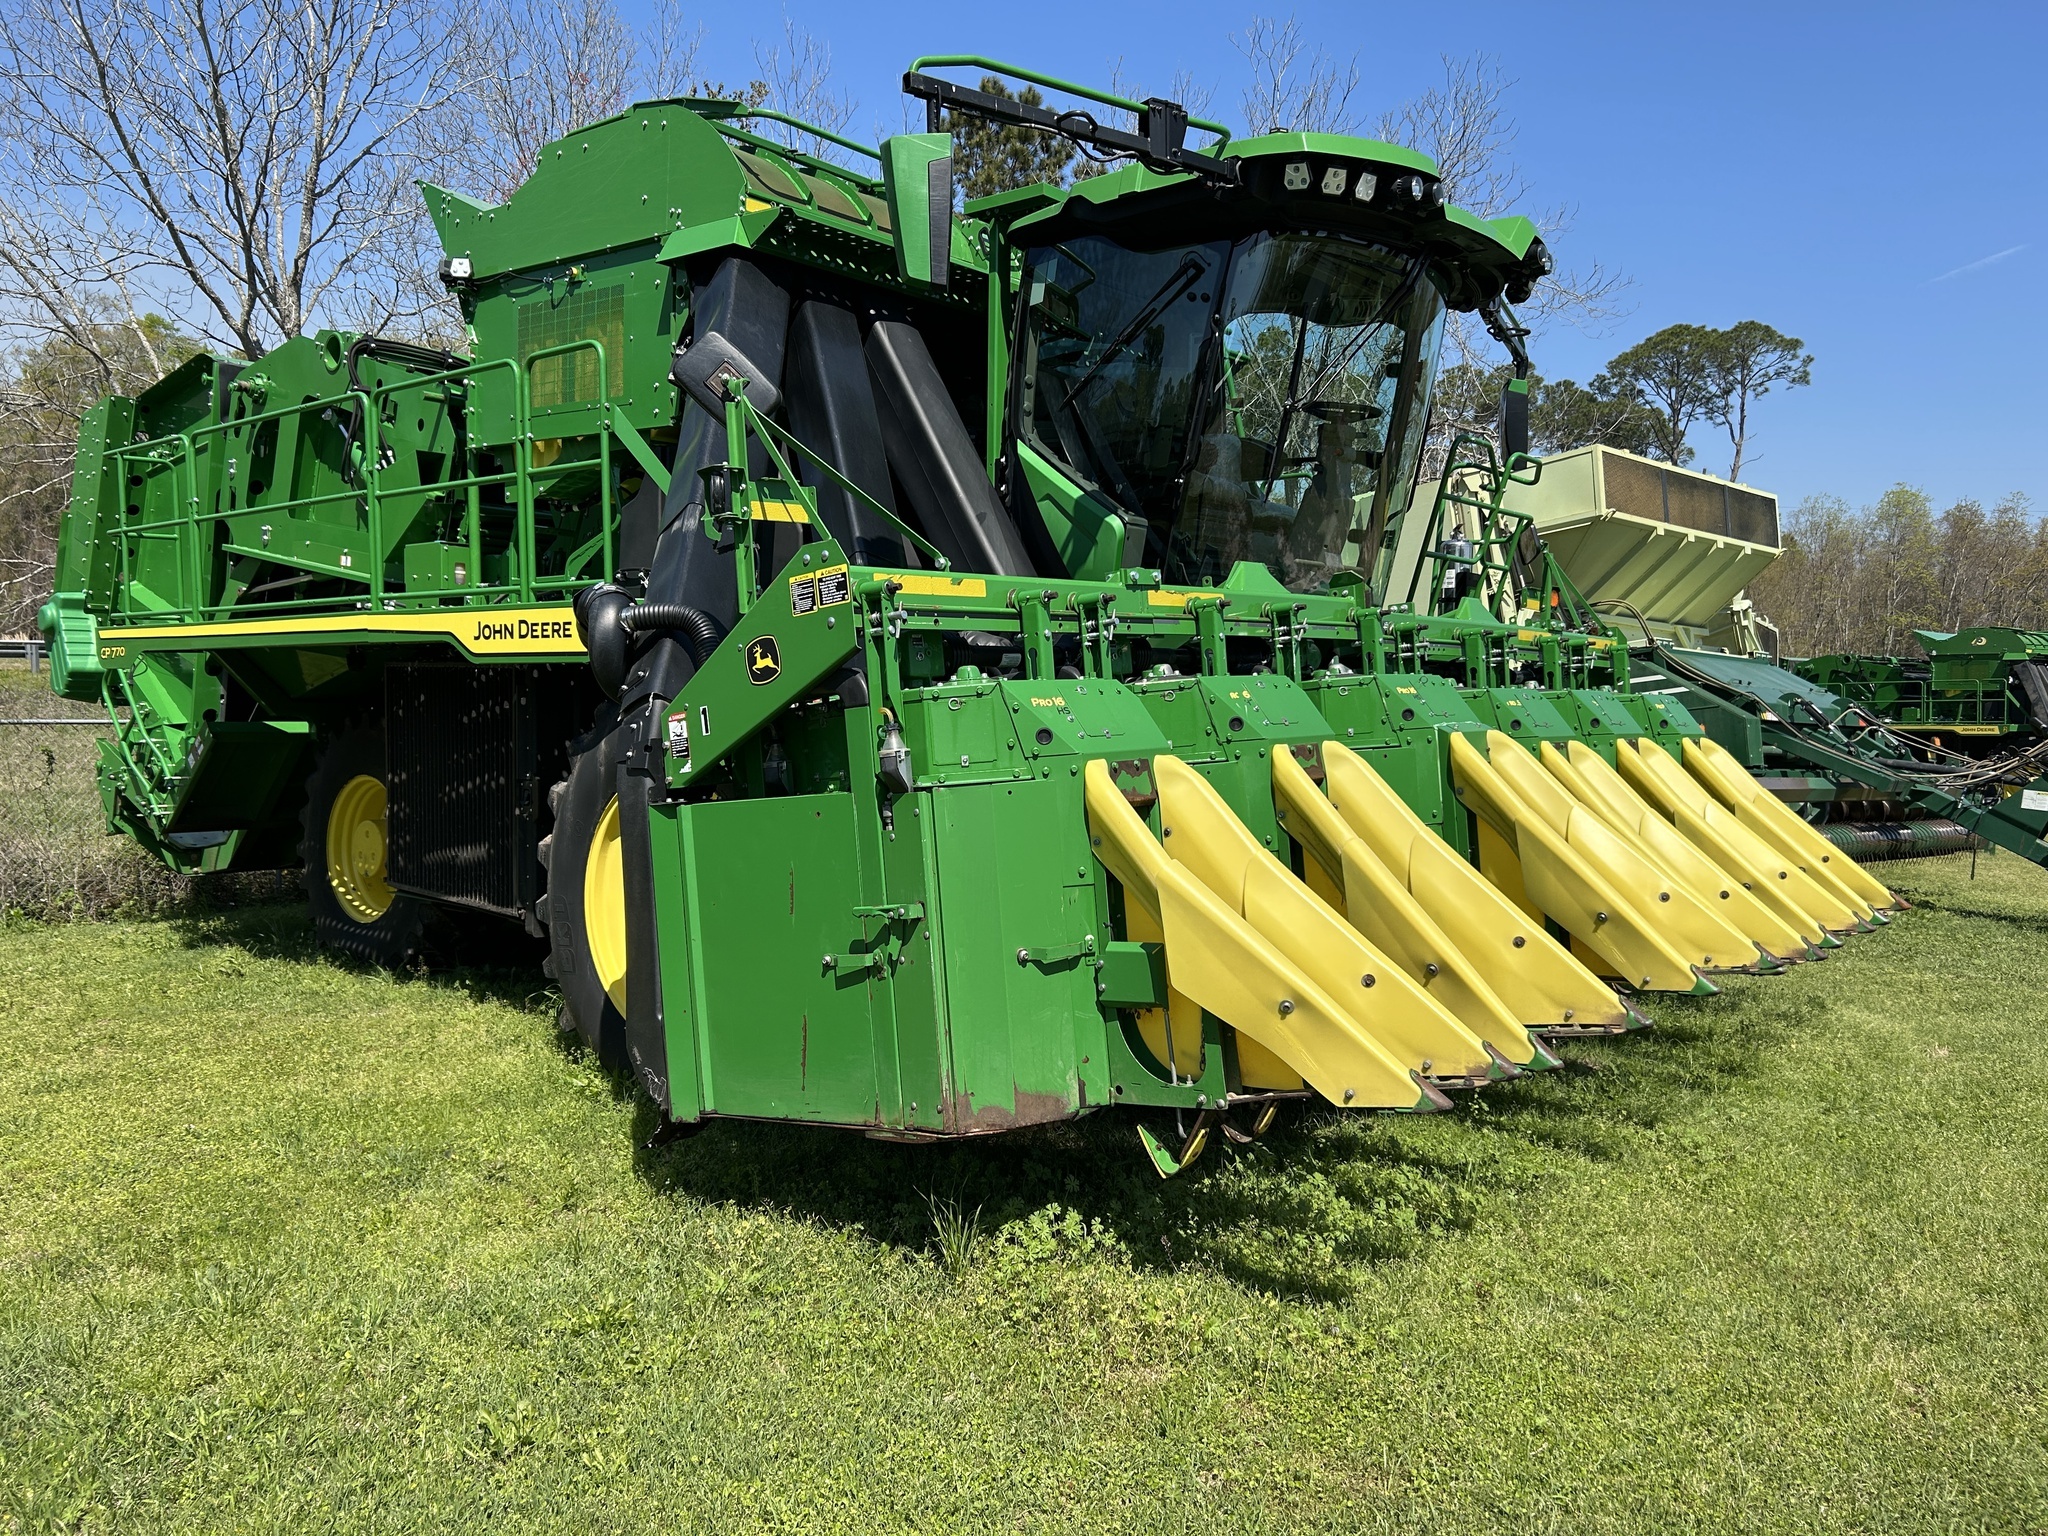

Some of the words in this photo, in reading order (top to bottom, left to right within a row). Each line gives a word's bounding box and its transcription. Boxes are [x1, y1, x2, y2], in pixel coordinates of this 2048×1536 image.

[825, 567, 842, 576] CAUTION
[473, 621, 514, 641] JOHN
[518, 619, 573, 639] DEERE
[100, 647, 111, 659] CP
[111, 646, 126, 659] 770
[1056, 706, 1071, 715] HS
[701, 707, 710, 734] 1
